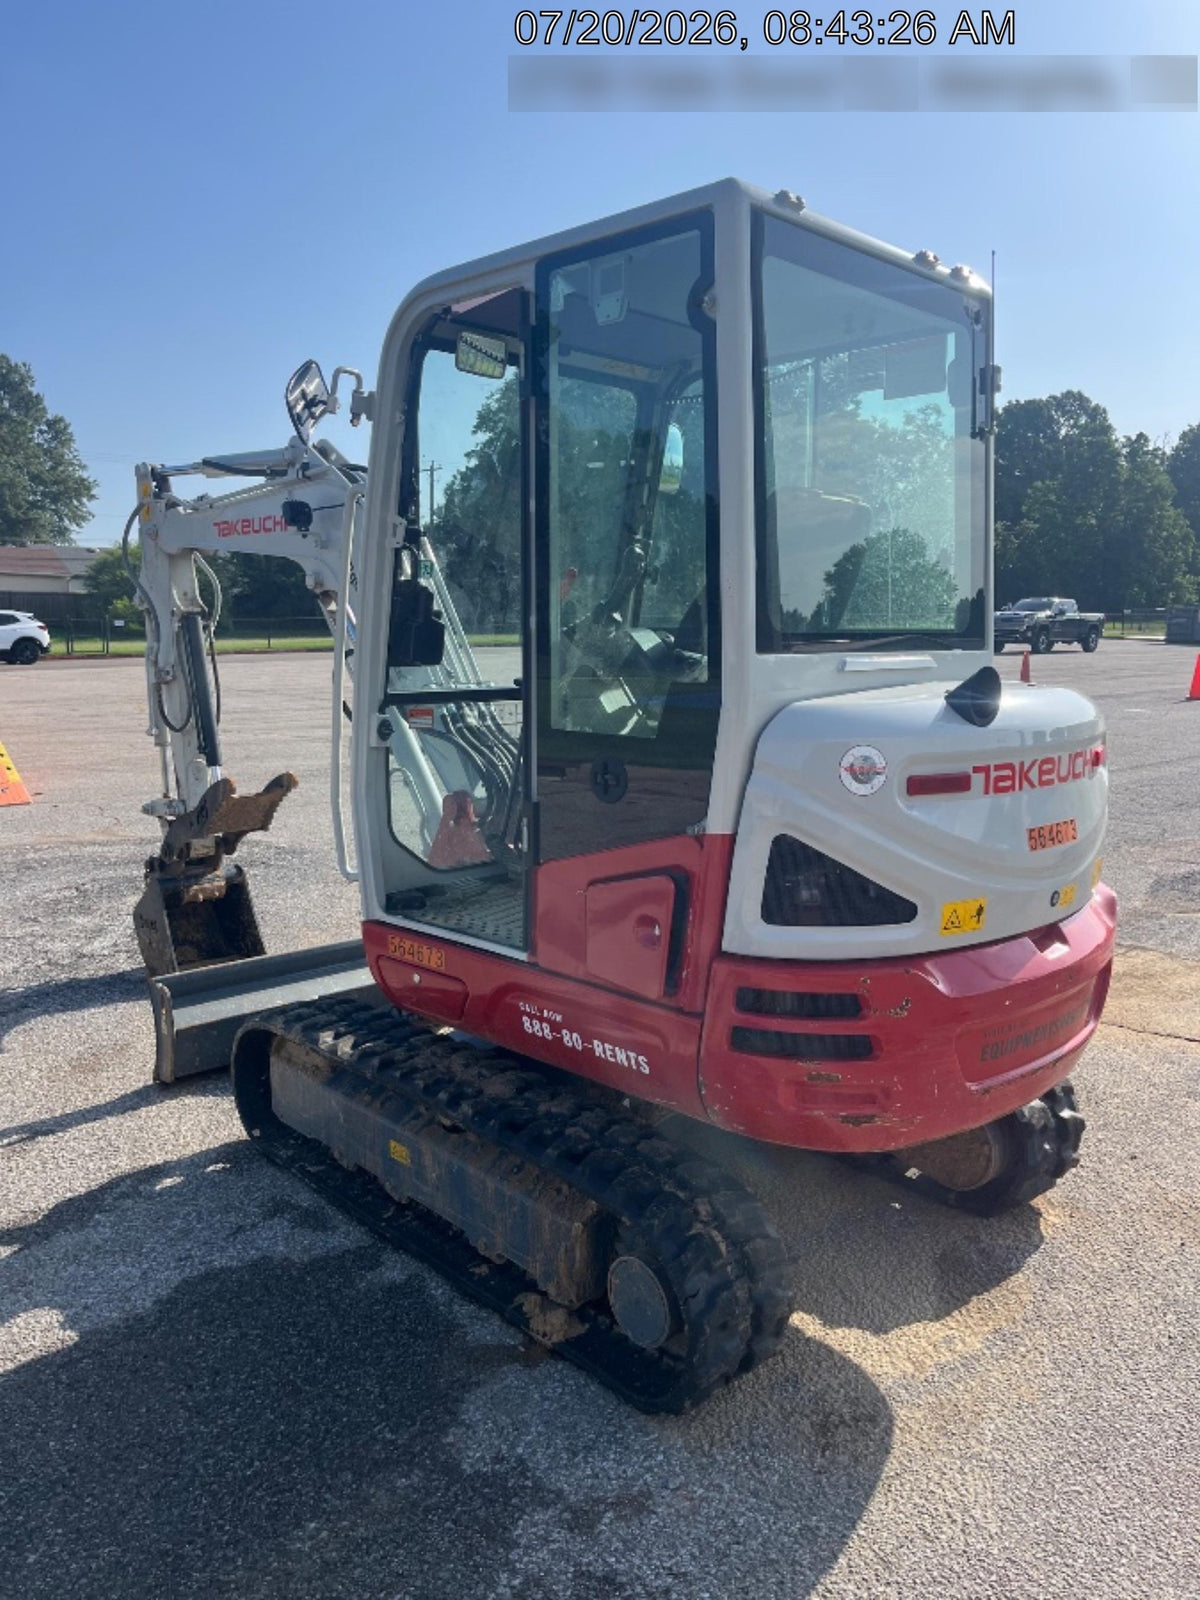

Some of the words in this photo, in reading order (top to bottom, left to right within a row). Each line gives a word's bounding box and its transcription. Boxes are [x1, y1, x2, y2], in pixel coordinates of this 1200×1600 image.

[972, 748, 1094, 795] TAKEUCH
[389, 936, 443, 968] 564673
[522, 1015, 650, 1075] 888-80-RENTS
